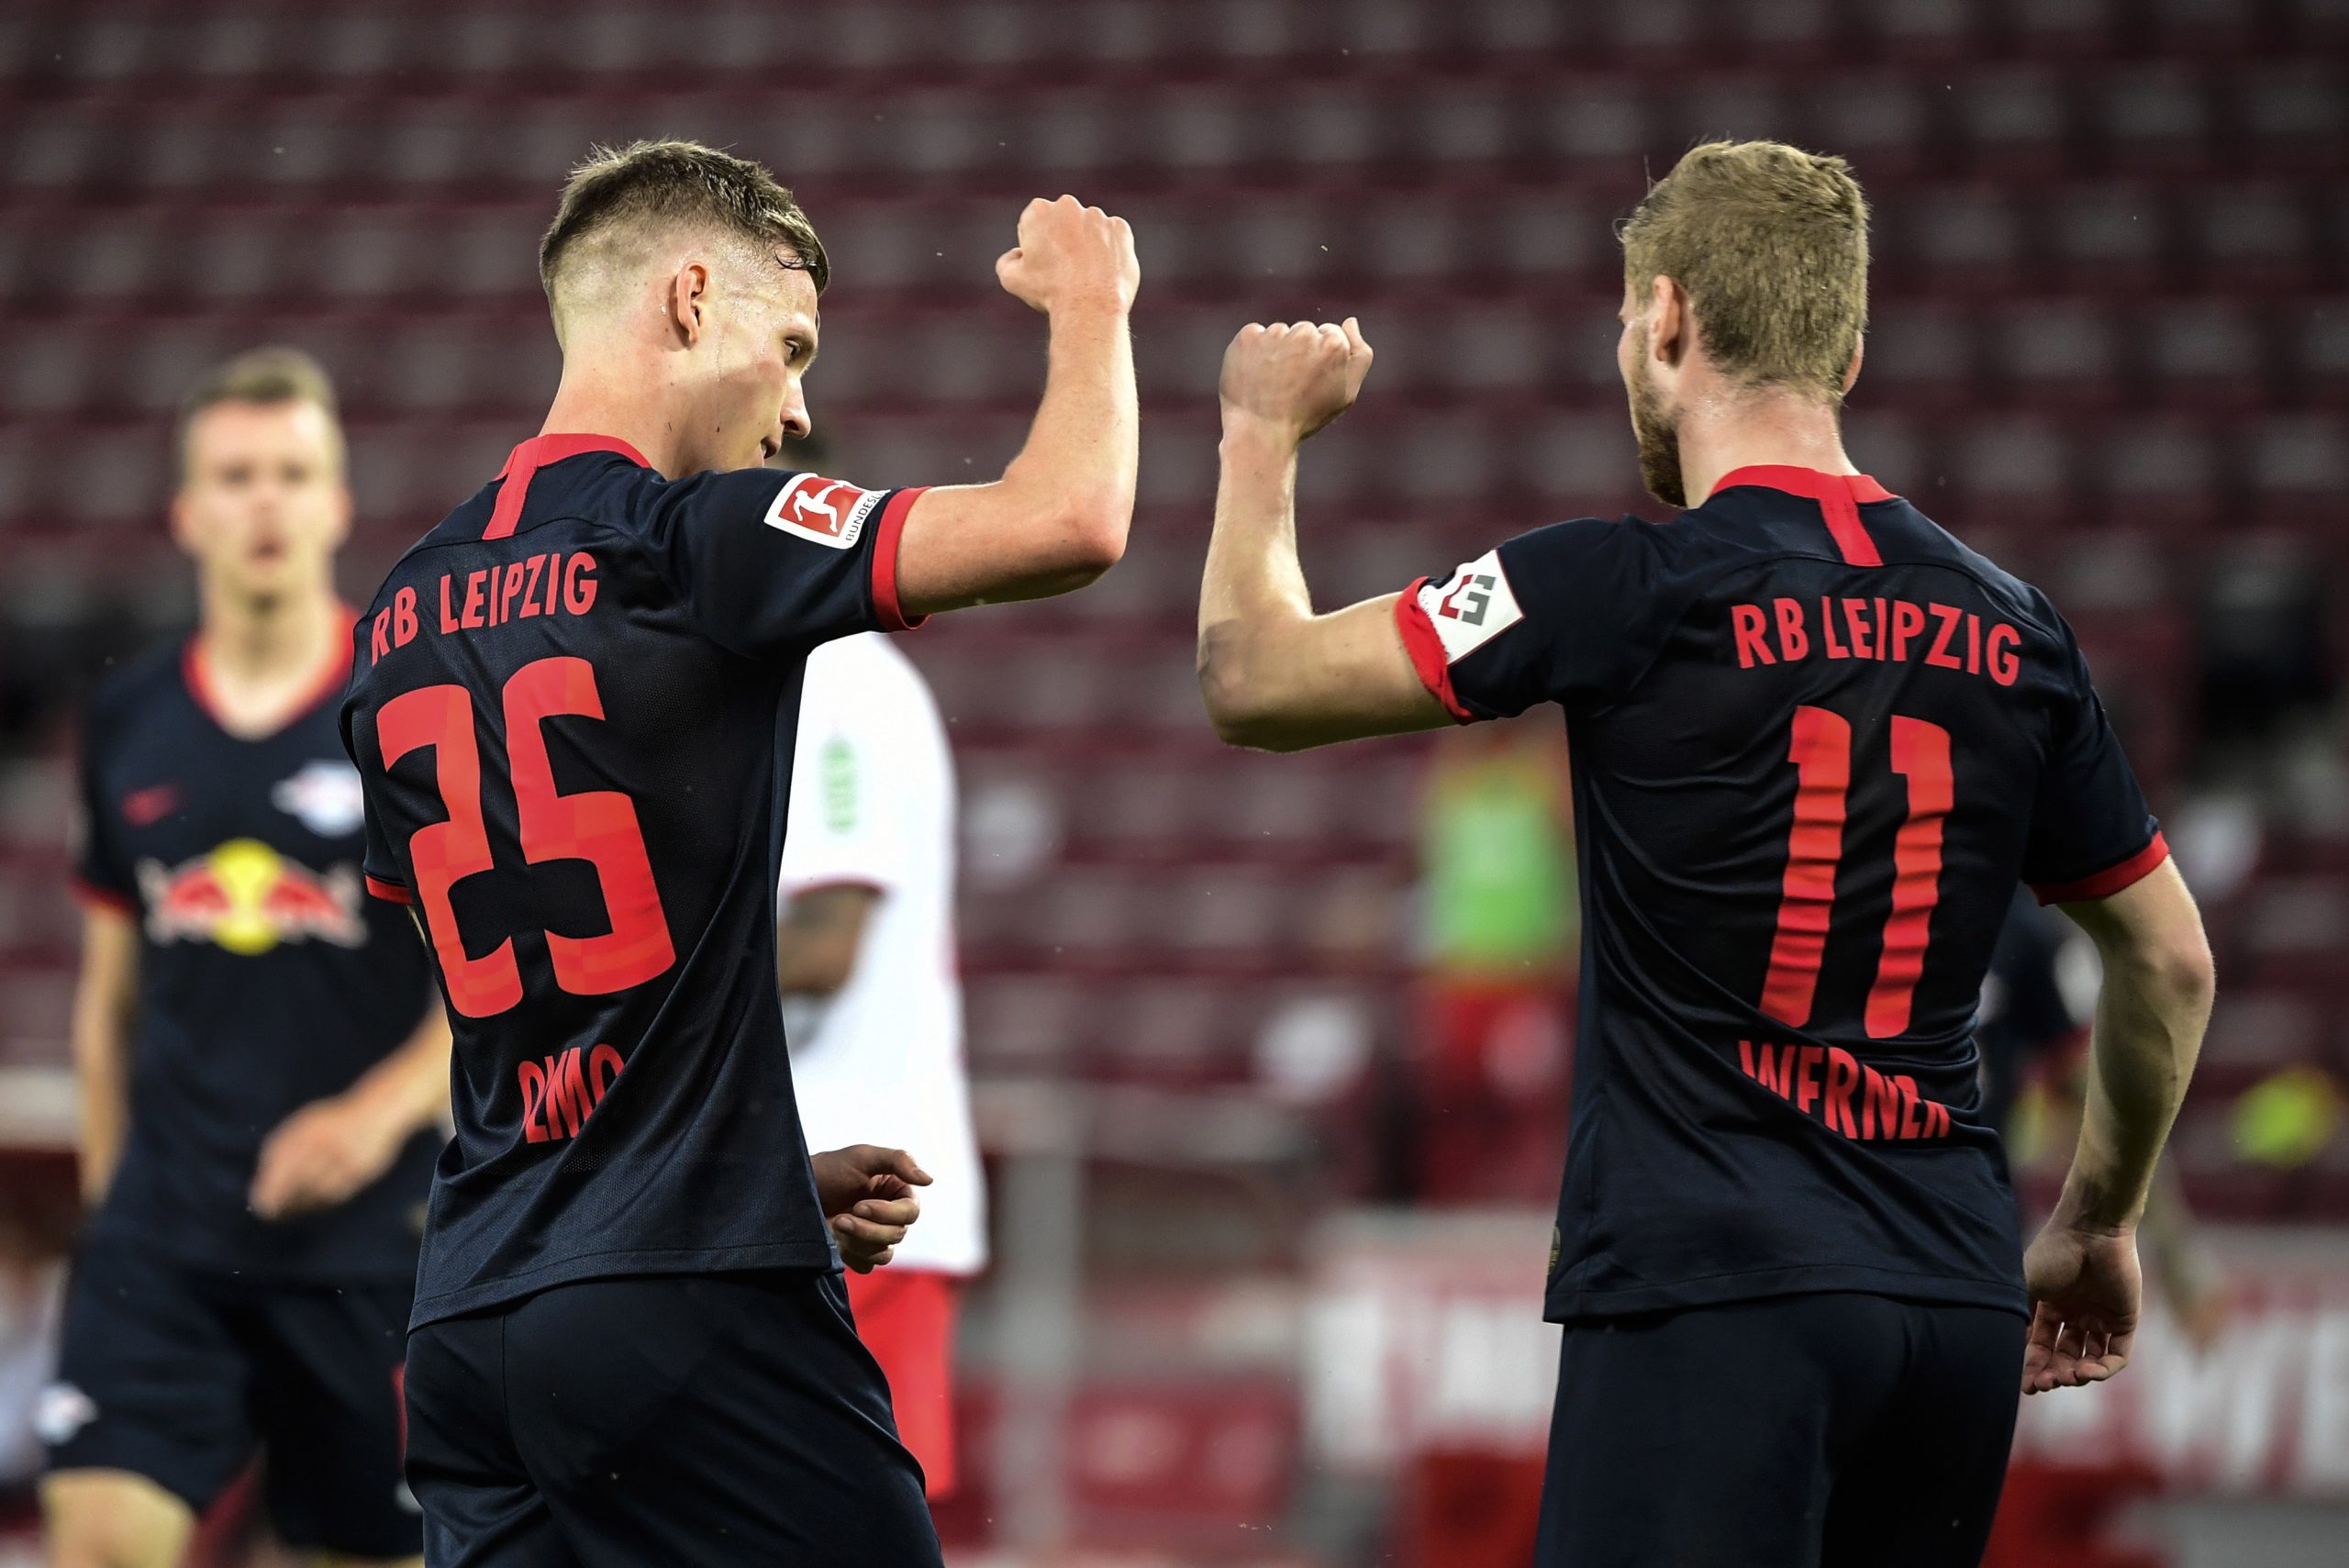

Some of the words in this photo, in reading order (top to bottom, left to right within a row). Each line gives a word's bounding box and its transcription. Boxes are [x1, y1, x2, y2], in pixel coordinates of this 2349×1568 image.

[372, 585, 418, 666] RB
[440, 551, 597, 634] LEIPZIG
[1731, 597, 1809, 669] RB
[1821, 595, 2021, 686] LEIPZIG
[376, 656, 676, 1018] 25
[1759, 705, 1954, 1039] 11
